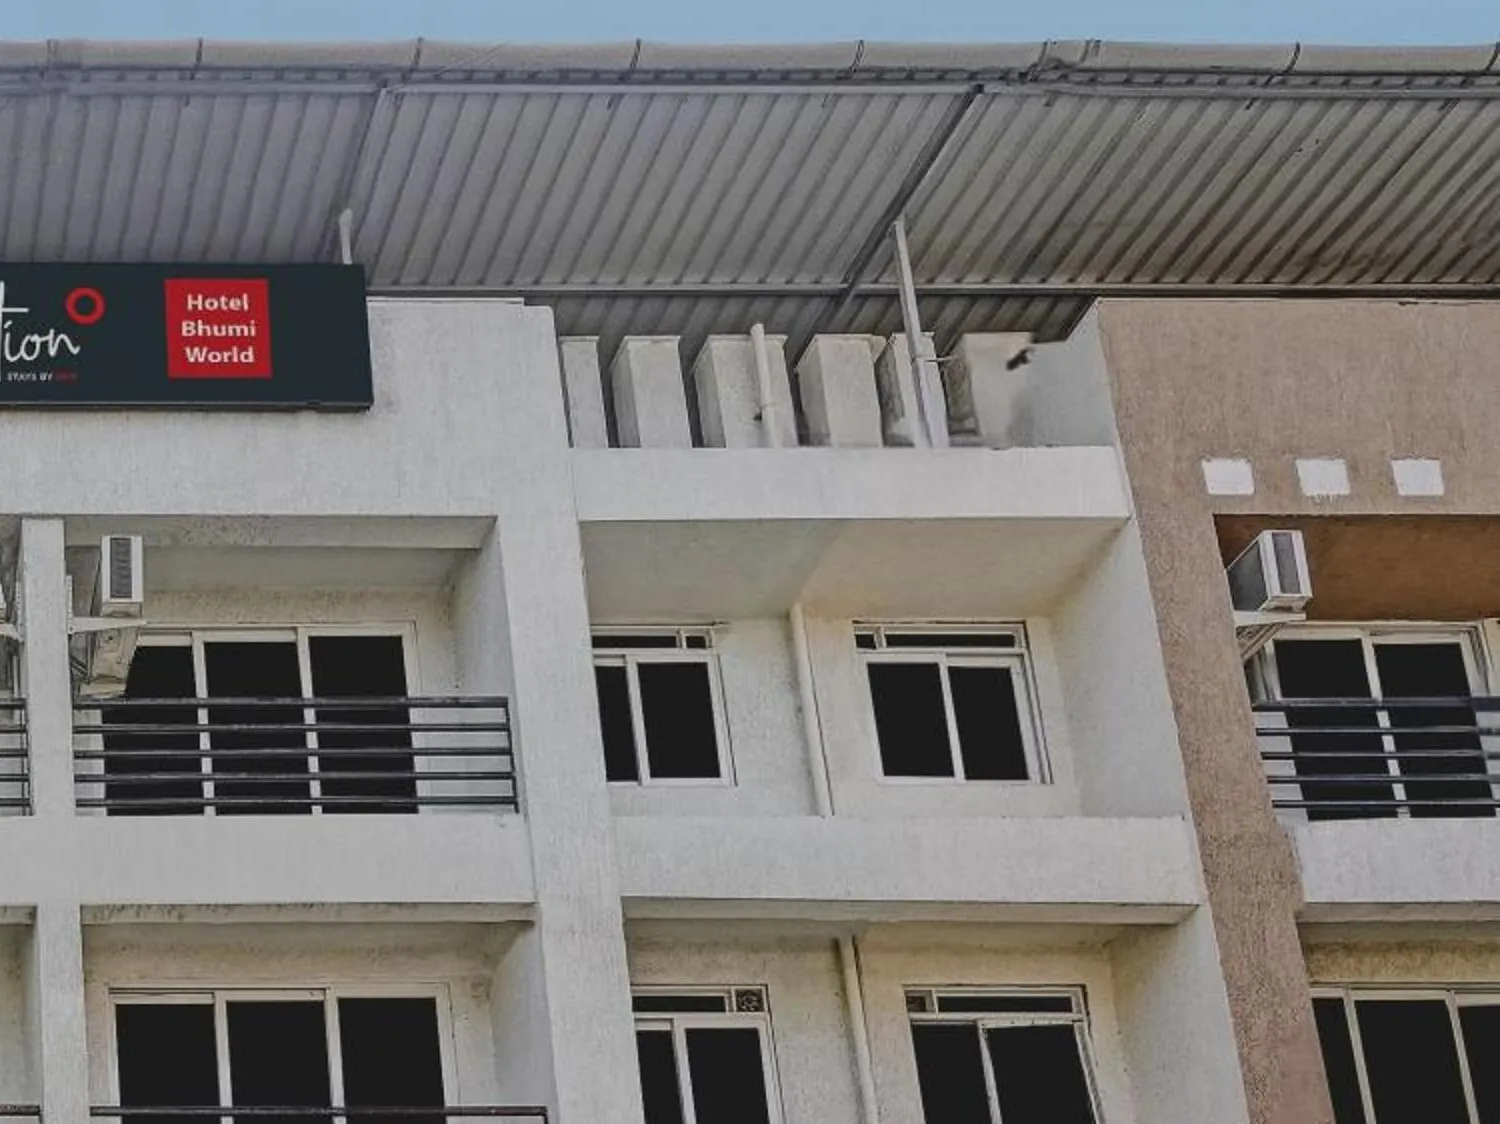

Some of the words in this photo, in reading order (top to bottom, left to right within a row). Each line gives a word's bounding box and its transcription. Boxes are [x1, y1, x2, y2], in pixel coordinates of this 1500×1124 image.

[186, 293, 249, 311] Hotel
[181, 319, 256, 337] Bhumi
[184, 345, 255, 363] World
[6, 371, 37, 382] STAYS
